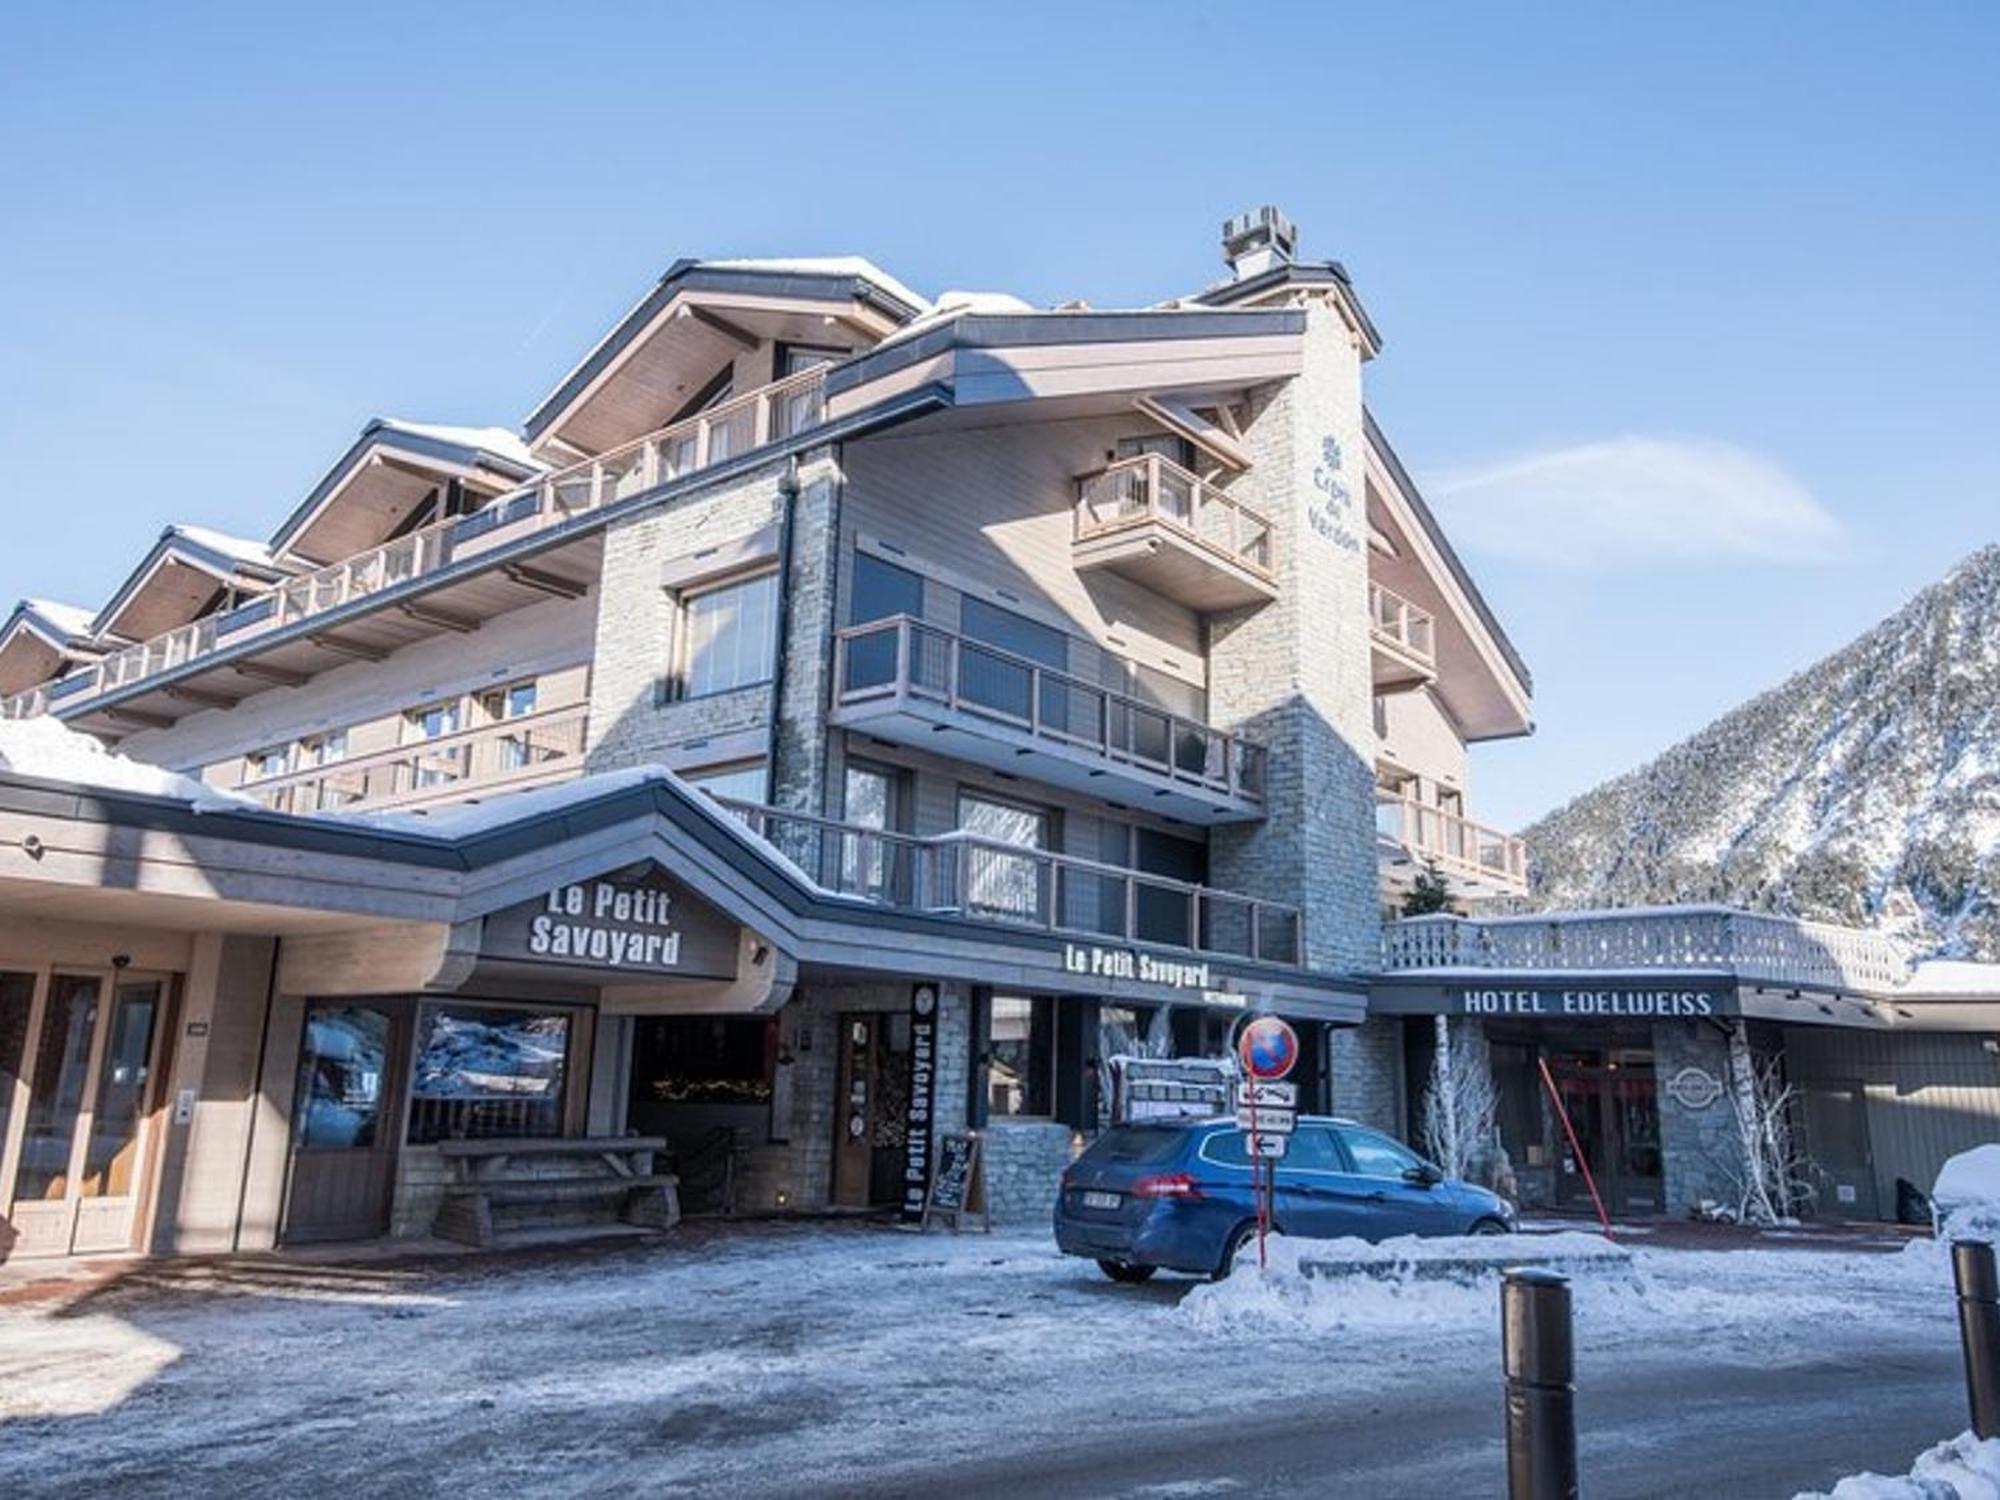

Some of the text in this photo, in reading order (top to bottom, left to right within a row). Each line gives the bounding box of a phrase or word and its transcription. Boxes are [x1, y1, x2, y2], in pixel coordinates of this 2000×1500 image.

[548, 882, 672, 925] Le Petit
[530, 915, 680, 965] Savoyard
[1066, 944, 1209, 988] Le Petit Savoyard
[1464, 991, 1712, 1015] HOTEL EDELWEISS
[909, 1024, 932, 1121] Savoyard
[906, 1128, 927, 1181] Petit
[904, 1188, 924, 1212] Le
